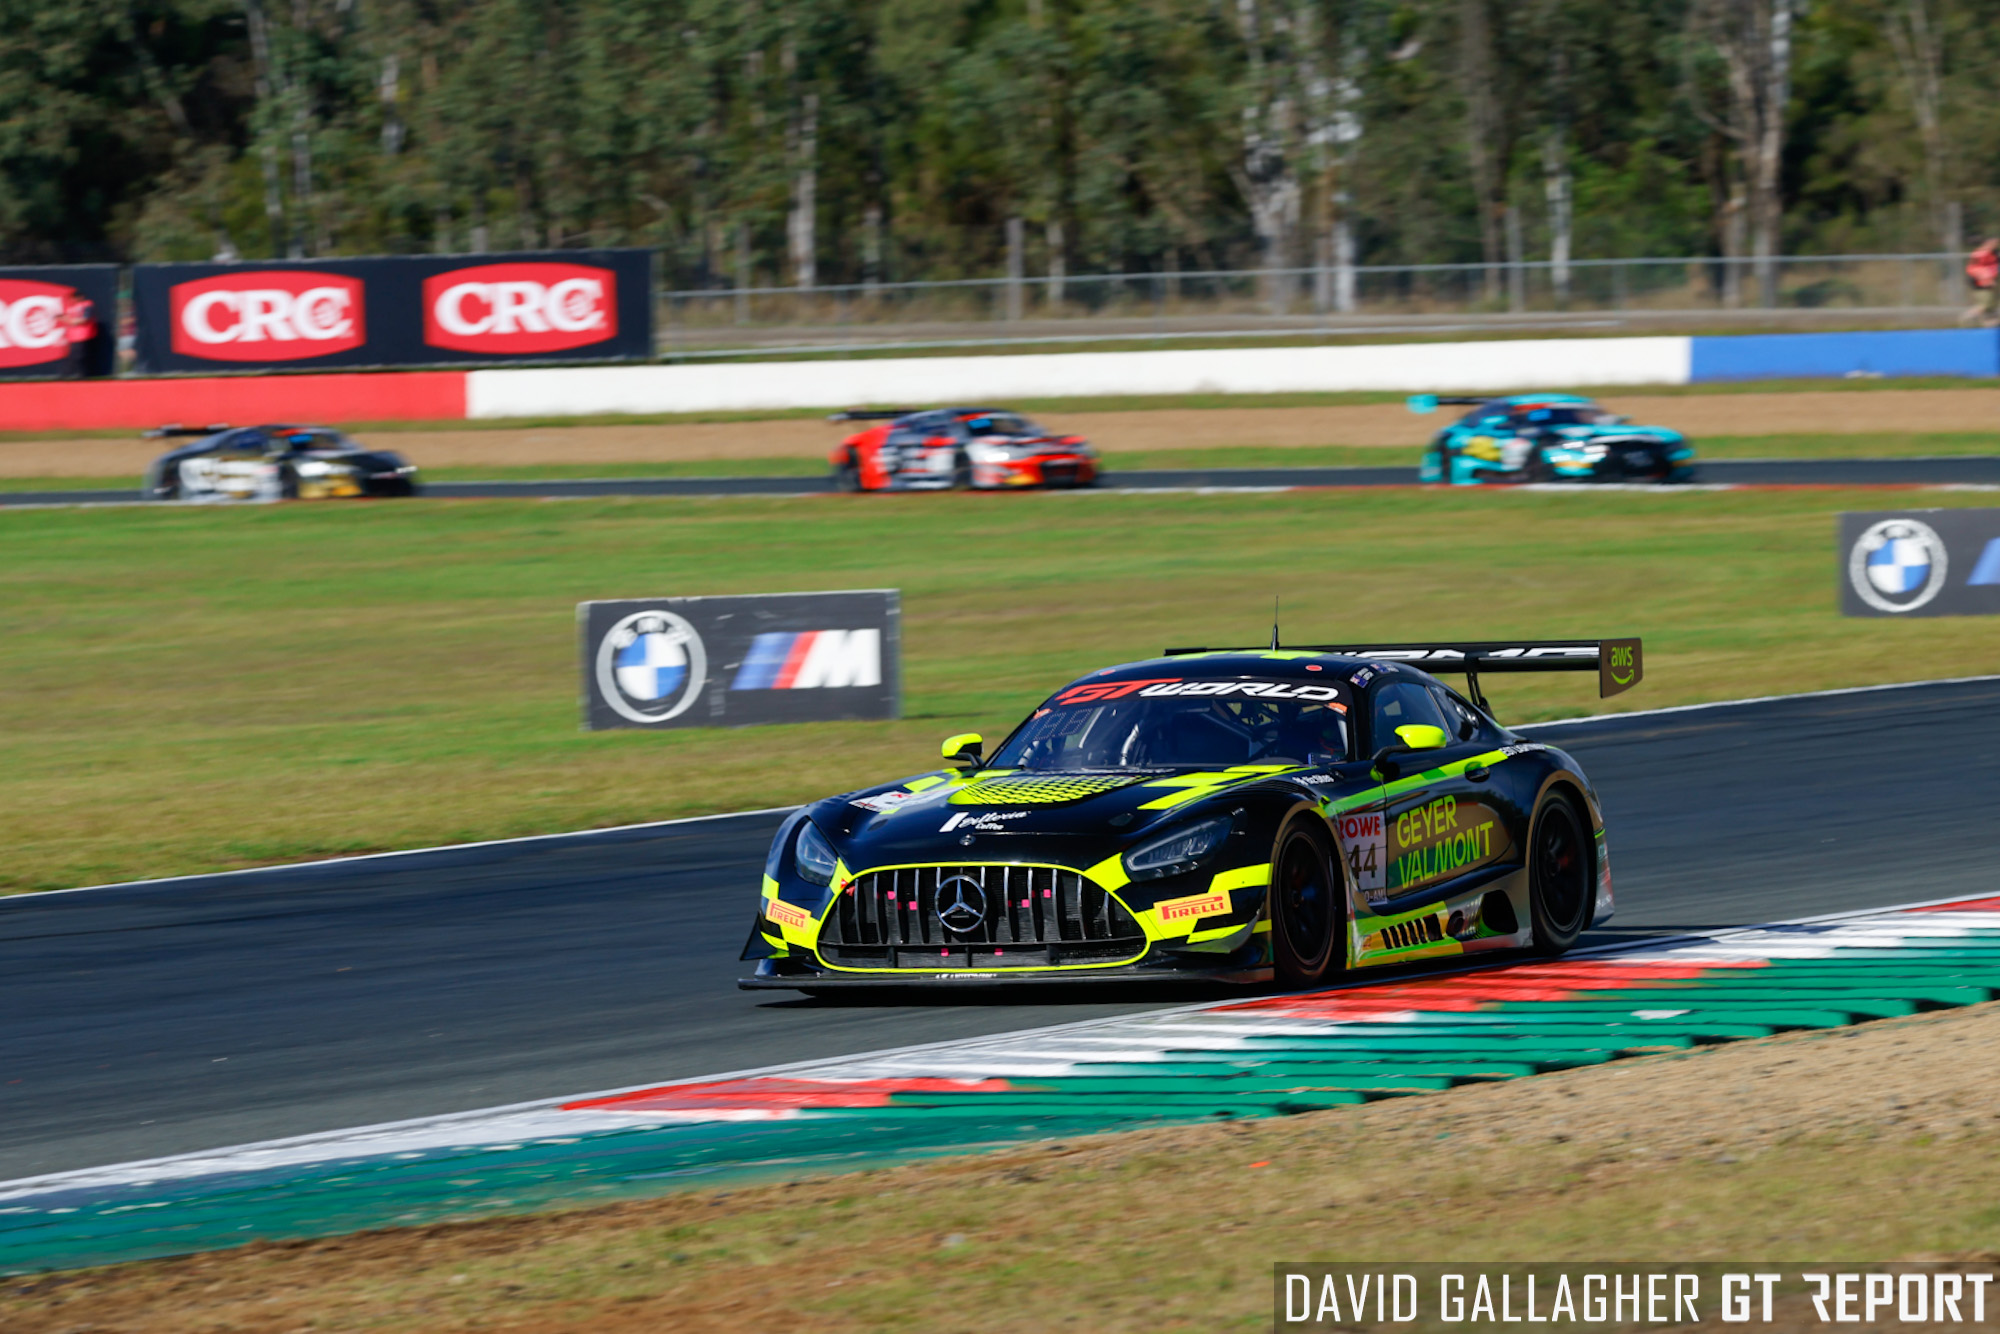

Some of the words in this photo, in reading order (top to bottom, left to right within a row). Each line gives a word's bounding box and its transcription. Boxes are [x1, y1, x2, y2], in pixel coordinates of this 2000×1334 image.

[182, 287, 353, 343] CRC
[434, 278, 606, 335] CRC
[1611, 646, 1633, 667] aws
[1336, 816, 1381, 841] ROWE
[1396, 794, 1458, 848] GEYER
[1350, 843, 1377, 879] 44
[1398, 820, 1494, 889] VALMONT
[770, 902, 806, 928] PIRELLI
[1161, 896, 1225, 920] PIRELLI
